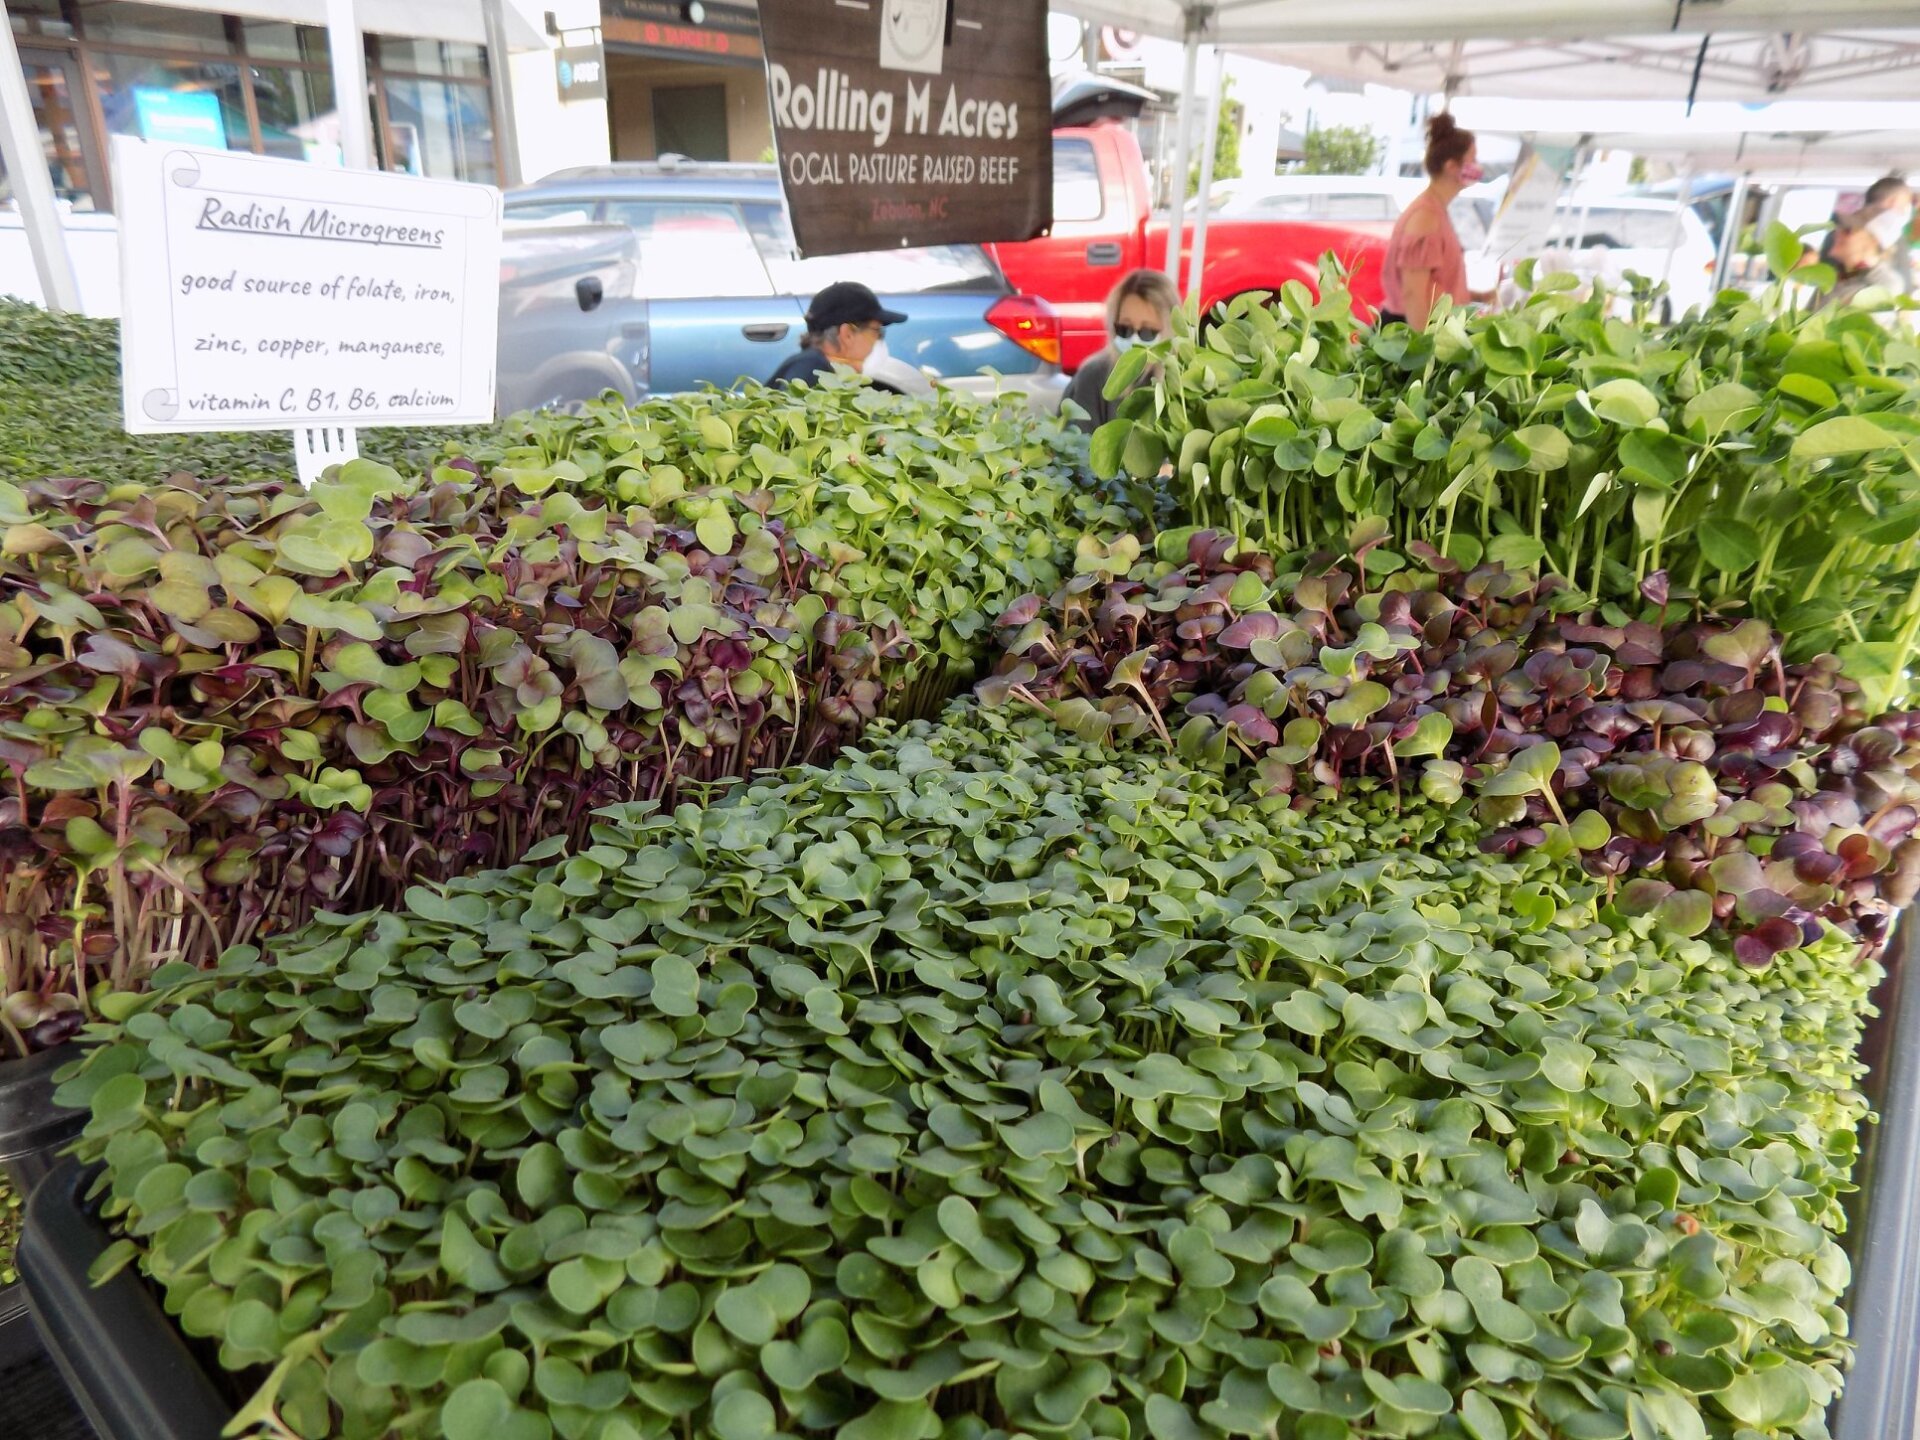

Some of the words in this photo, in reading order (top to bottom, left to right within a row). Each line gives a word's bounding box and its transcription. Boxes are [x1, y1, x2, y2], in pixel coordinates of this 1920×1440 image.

[770, 63, 893, 148] Rolling
[904, 76, 931, 135] M
[938, 82, 1018, 140] Acres
[784, 151, 844, 185] OCAL
[850, 153, 918, 184] PASTURE
[923, 155, 975, 184] RAISED
[979, 157, 1019, 184] BEEF
[199, 197, 291, 232] Radish
[299, 208, 445, 246] Microgreens
[181, 270, 237, 294] good
[244, 276, 312, 296] source
[320, 275, 345, 300] of
[347, 275, 406, 303] folate,
[414, 282, 455, 303] iron,
[194, 333, 247, 355] zinc,
[258, 337, 329, 360] copper,
[338, 339, 445, 360] manganese,
[189, 392, 270, 411] vitamin
[279, 387, 297, 412] C,
[306, 387, 339, 412] B1,
[348, 387, 380, 411] B6,
[388, 388, 454, 408] calcium
